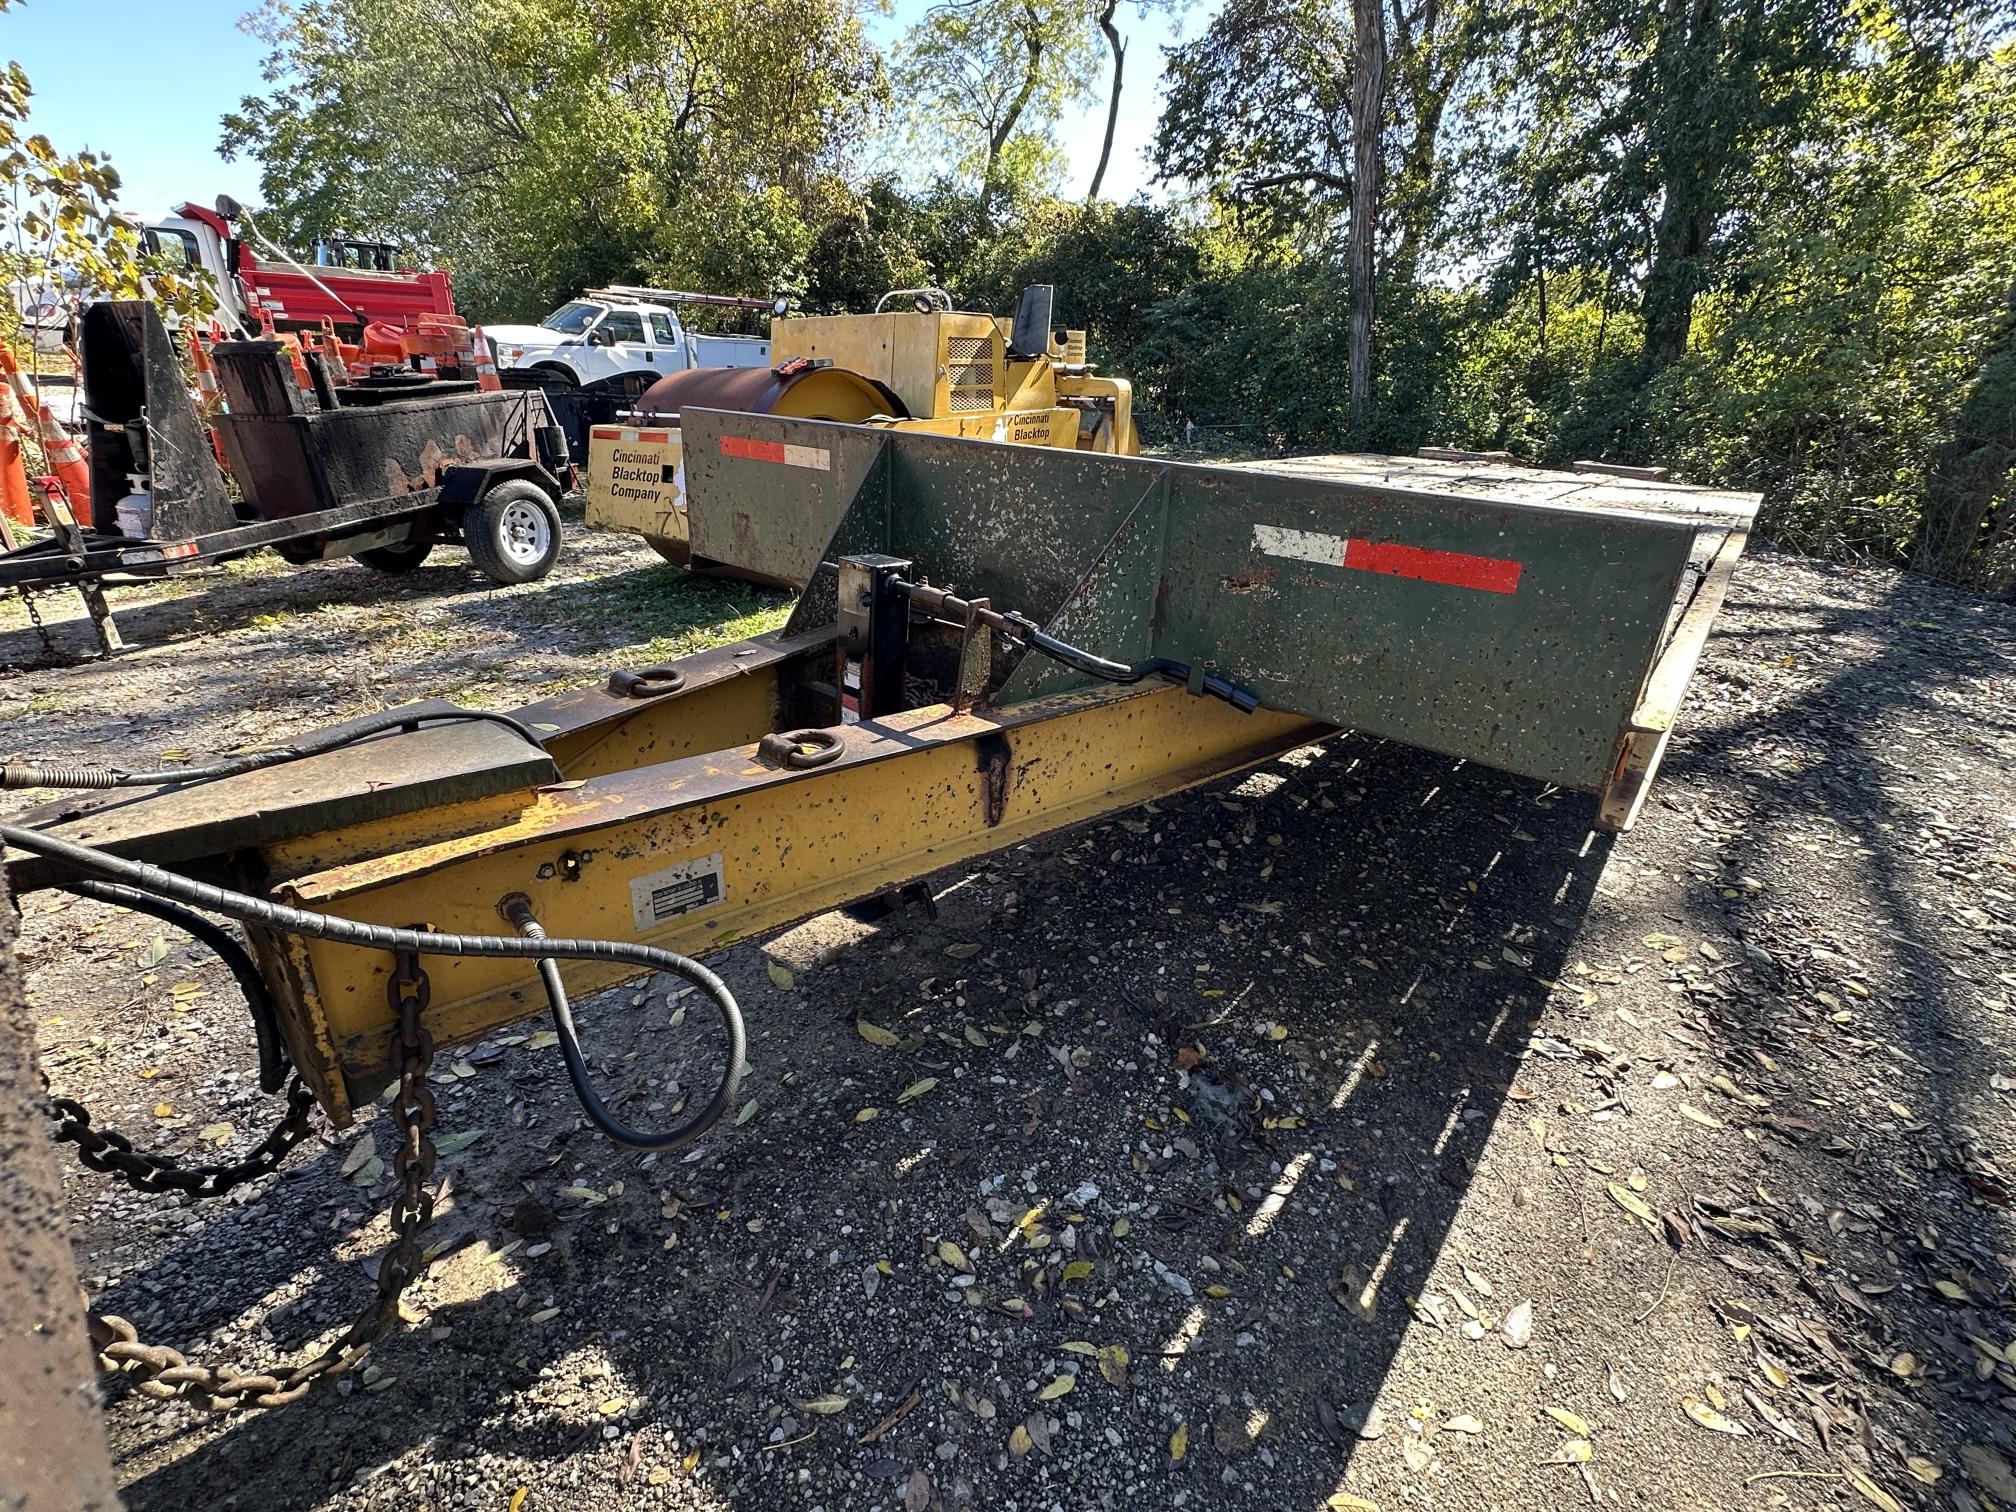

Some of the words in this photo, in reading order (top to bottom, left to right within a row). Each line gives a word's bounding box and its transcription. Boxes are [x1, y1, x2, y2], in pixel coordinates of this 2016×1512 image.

[1014, 413, 1050, 426] Cincinnati
[1014, 428, 1050, 440] Blacktop
[612, 448, 661, 465] Cincinnati
[612, 466, 660, 486] Blacktop
[611, 483, 661, 503] Company
